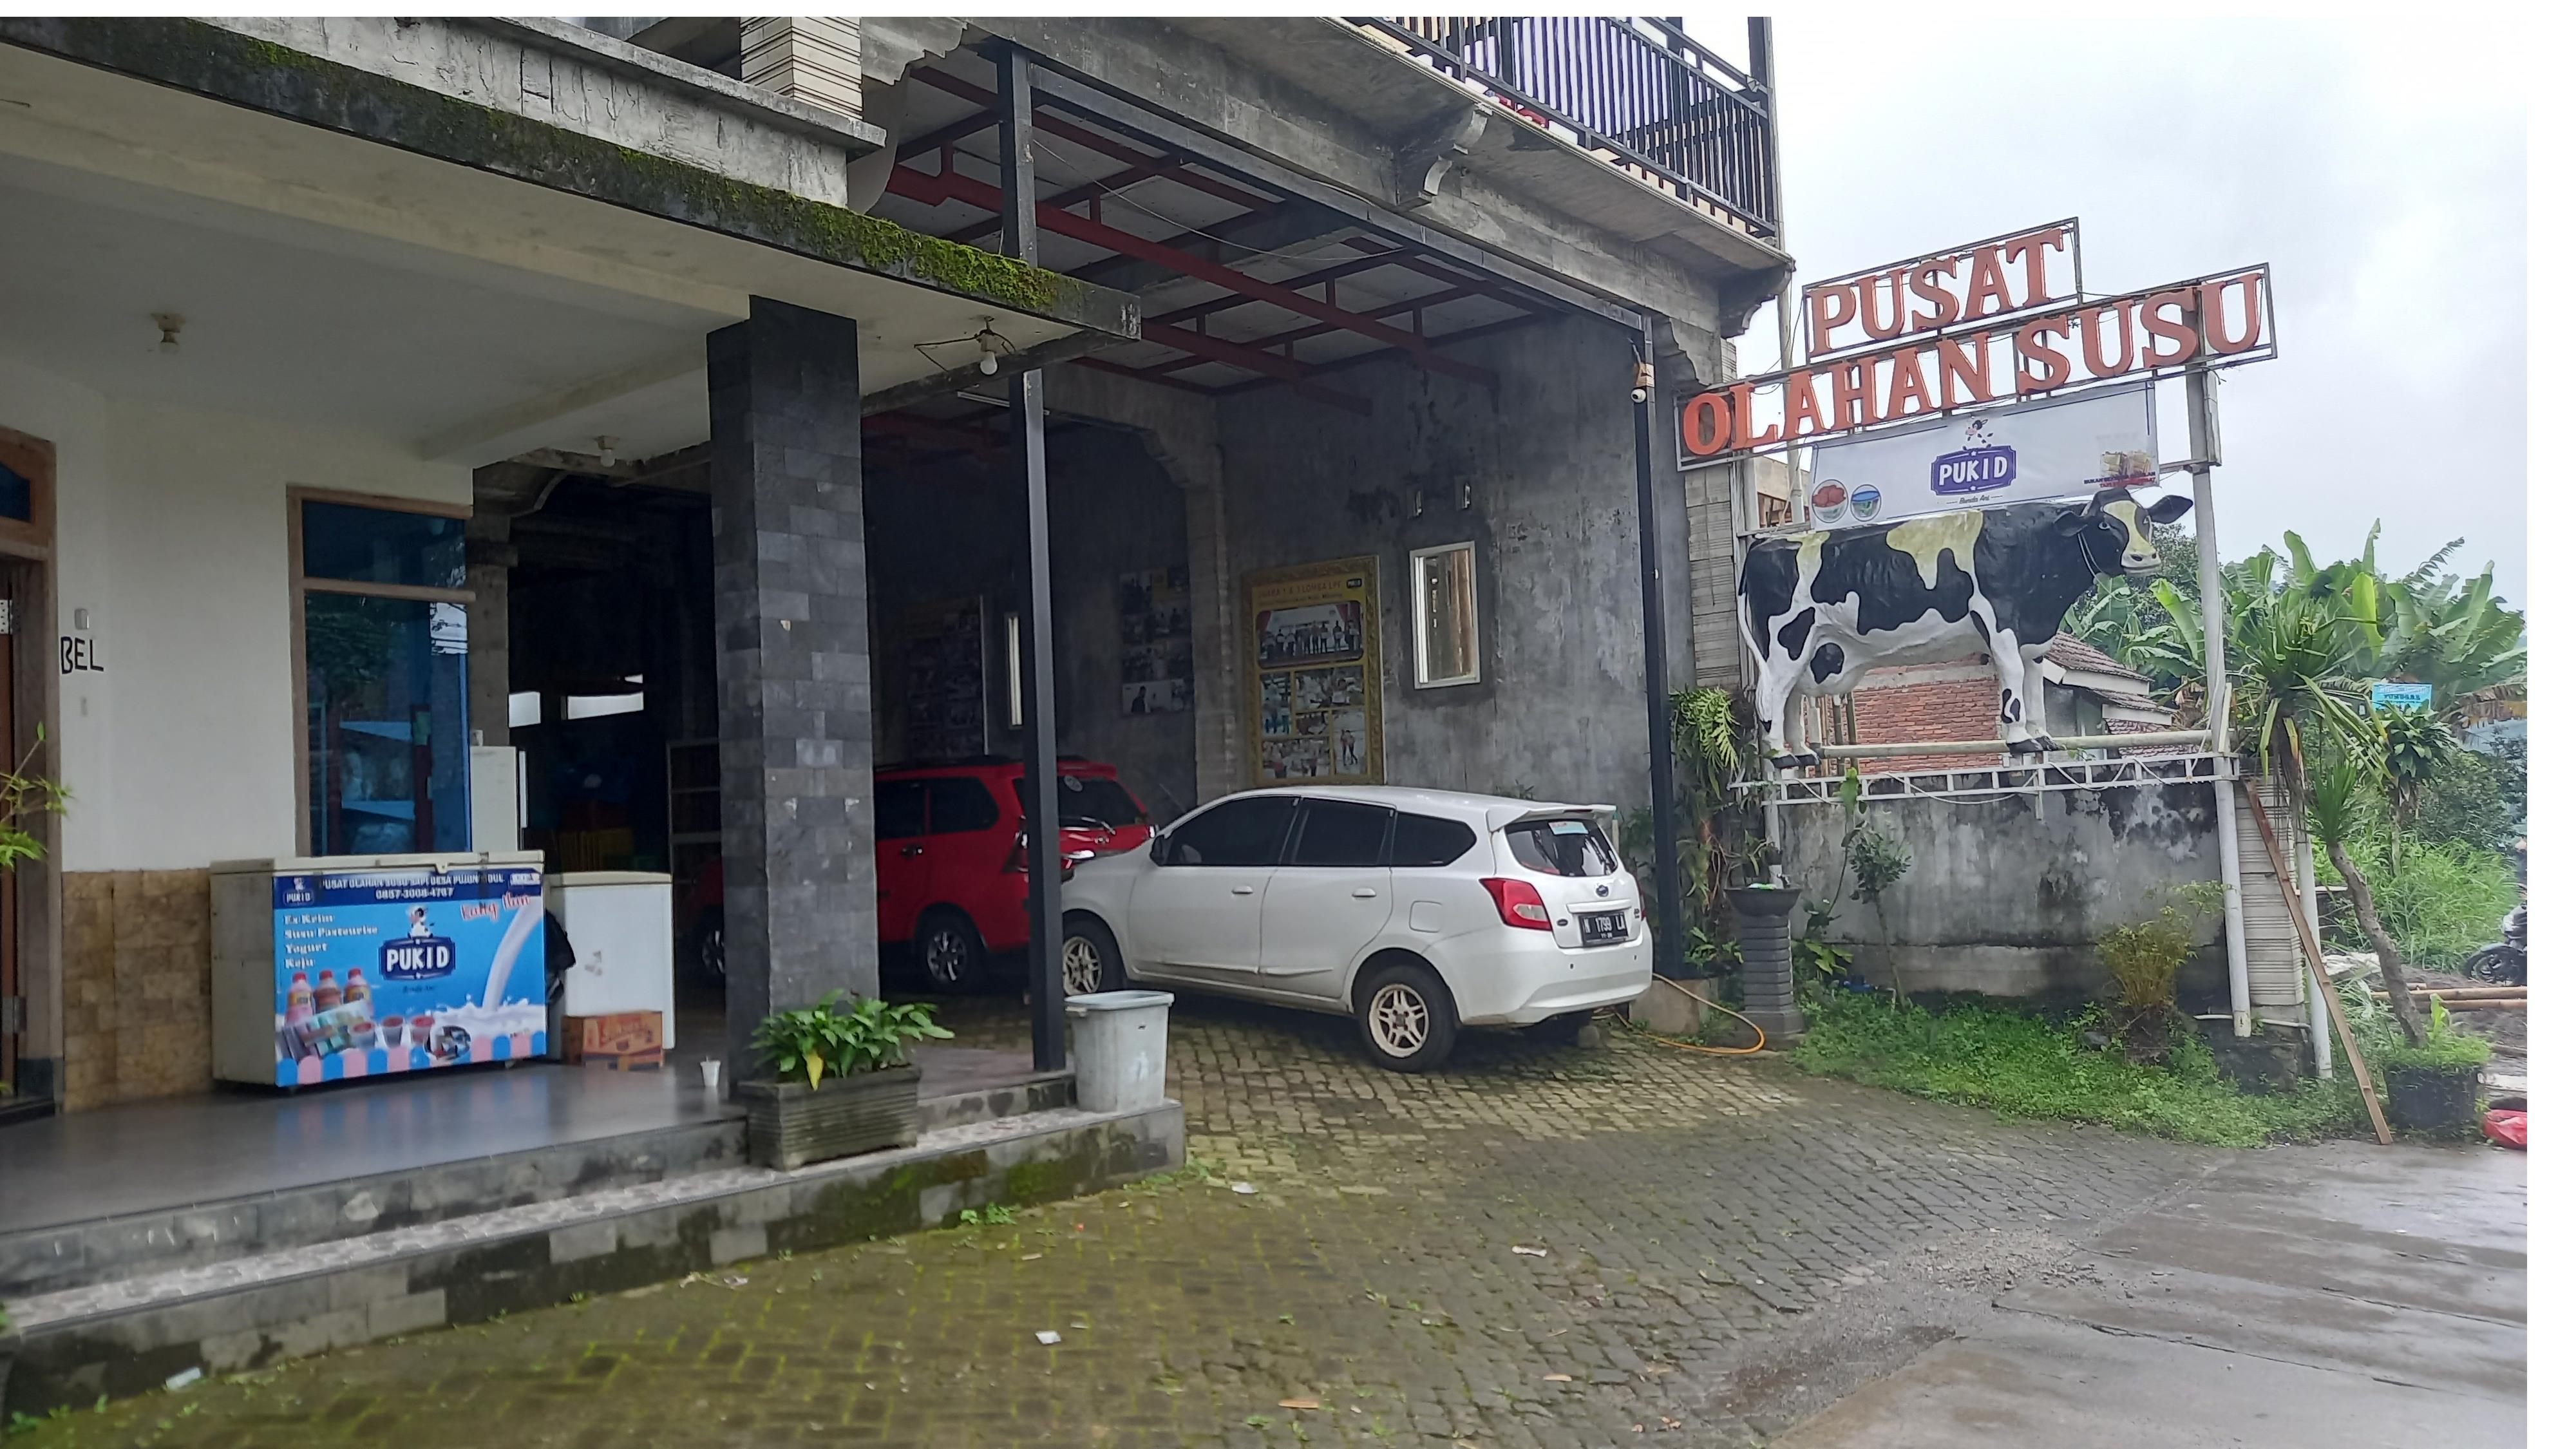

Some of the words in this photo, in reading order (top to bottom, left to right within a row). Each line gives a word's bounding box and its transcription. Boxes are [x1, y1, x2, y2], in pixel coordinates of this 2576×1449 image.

[1806, 228, 2064, 354] PUSAT
[1683, 331, 1996, 456] OLAHAN
[2018, 272, 2262, 395] SUSU
[1938, 457, 2009, 486] PUKID
[61, 636, 104, 674] BEL
[322, 878, 347, 890] USAT
[1595, 916, 1613, 933] 1799
[386, 945, 450, 972] PUKID
